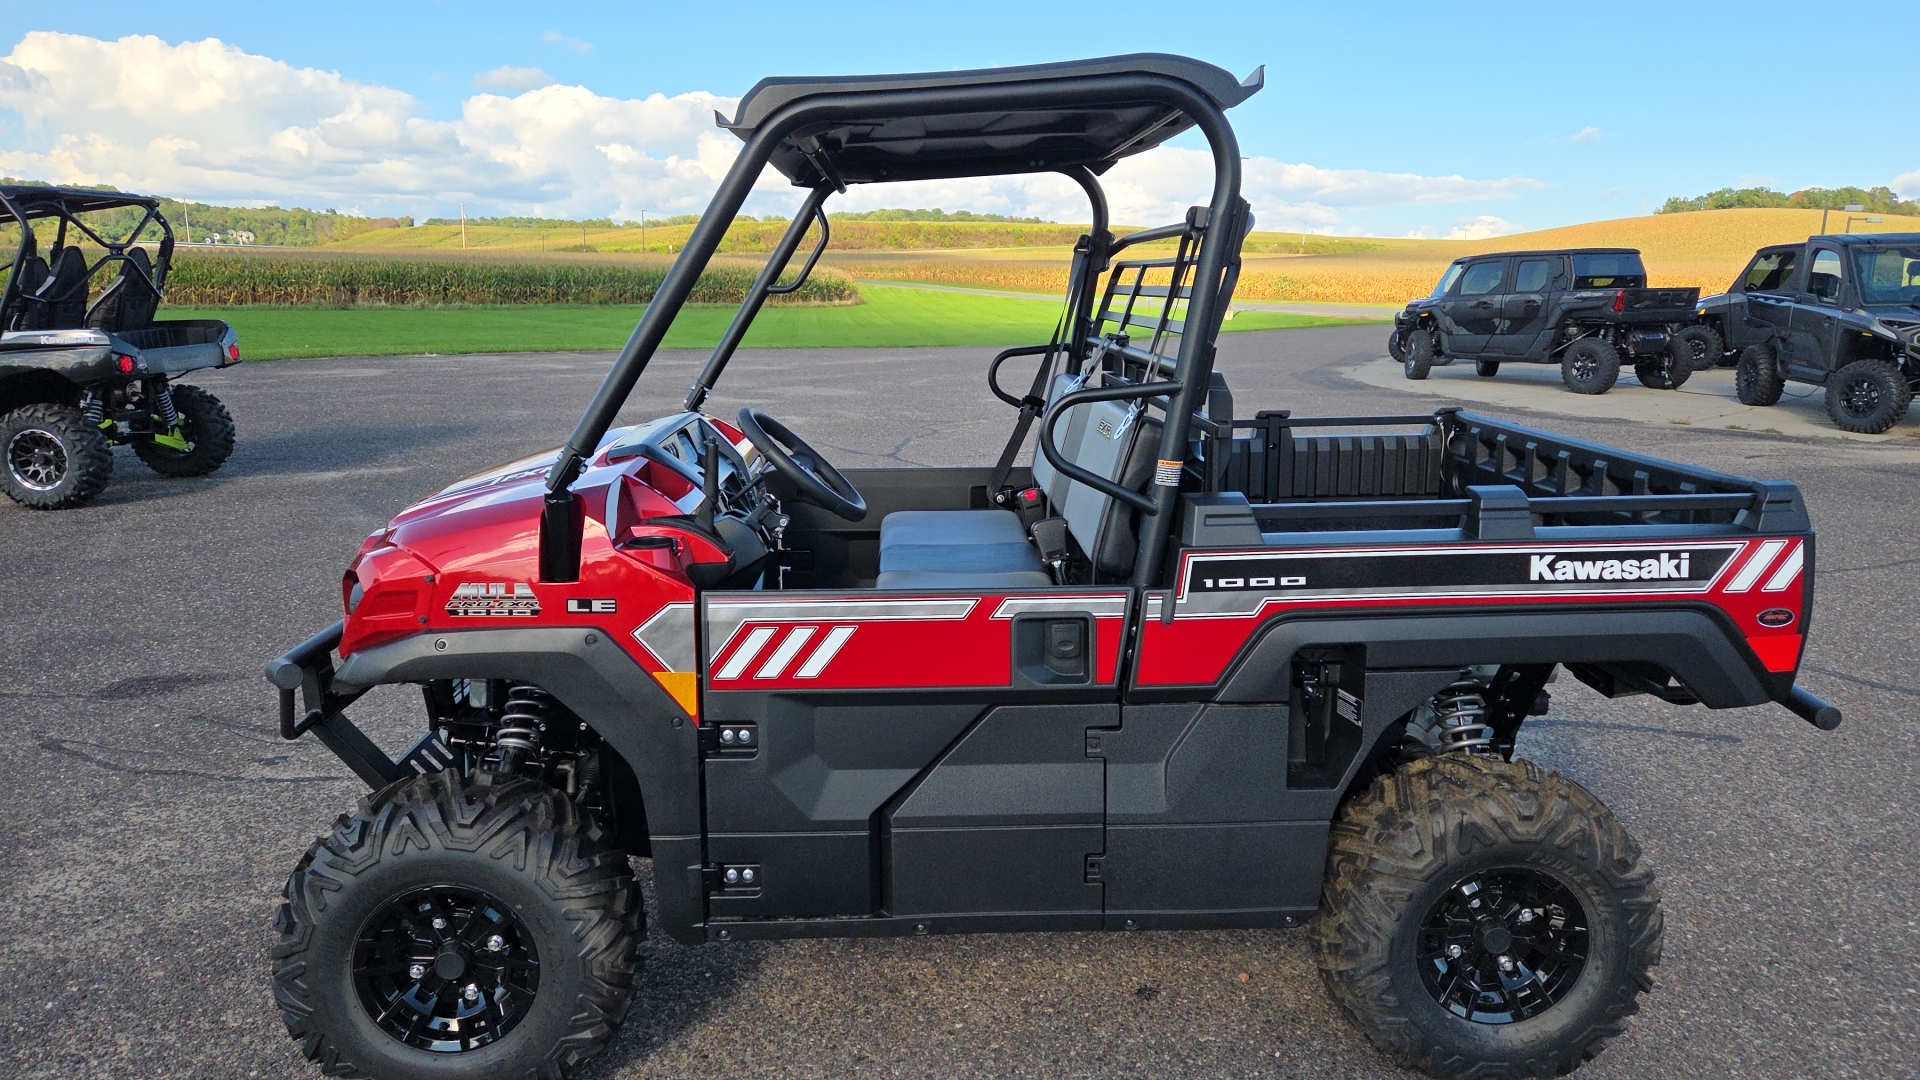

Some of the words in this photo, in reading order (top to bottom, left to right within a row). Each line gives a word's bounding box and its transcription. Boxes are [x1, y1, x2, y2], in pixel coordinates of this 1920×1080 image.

[40, 335, 95, 345] Kawasaki
[1530, 553, 1689, 581] Kawasaki
[1203, 576, 1307, 588] 1000
[450, 583, 538, 600] MULE
[567, 599, 616, 612] LE
